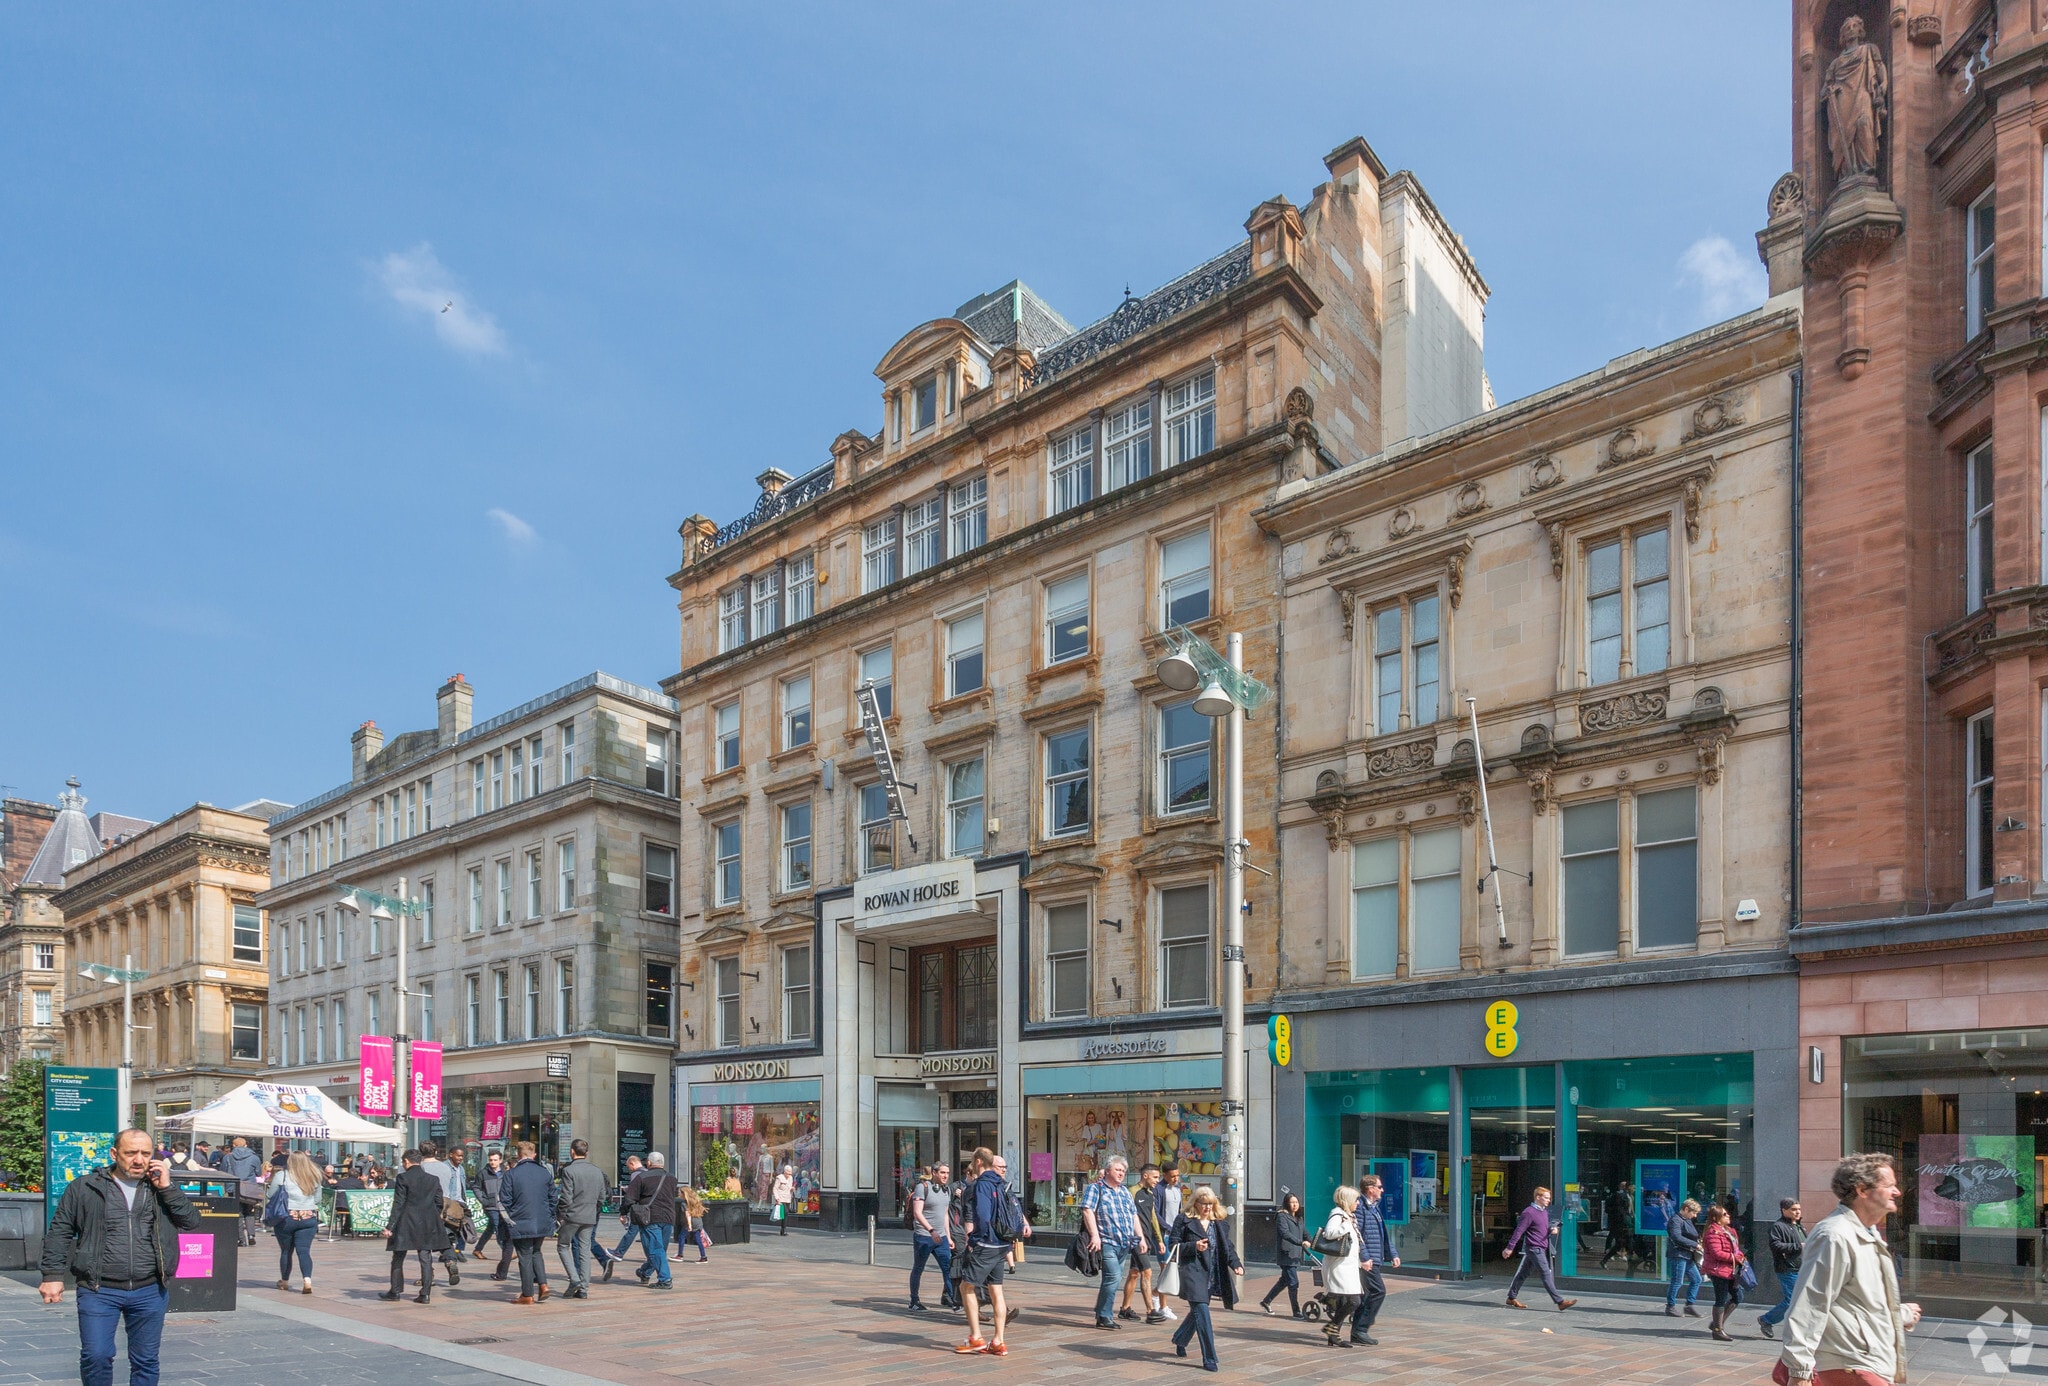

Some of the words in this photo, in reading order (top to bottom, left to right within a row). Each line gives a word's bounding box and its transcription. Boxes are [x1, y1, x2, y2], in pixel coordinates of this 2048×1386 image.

[864, 889, 910, 911] ROWAN
[913, 880, 960, 902] HOUSE
[1496, 1008, 1506, 1049] EE
[1083, 1038, 1167, 1059] Accessorize
[713, 1060, 790, 1081] MONSOON
[920, 1055, 994, 1073] MONSOON
[257, 1083, 274, 1093] BIG
[275, 1084, 310, 1095] WILLIE
[363, 1067, 373, 1109] GLASGOW
[371, 1085, 380, 1110] MAKE
[380, 1080, 389, 1111] PEOPLE
[414, 1072, 423, 1113] GLASGOW
[429, 1084, 438, 1114] PEOPLE
[421, 1090, 430, 1113] MAKE
[273, 1125, 290, 1137] BIG
[293, 1126, 330, 1139] WILLIE
[1915, 1163, 1971, 1177] Master
[1970, 1164, 2023, 1180] Origin
[363, 1195, 391, 1210] INNIS
[383, 1203, 391, 1211] &
